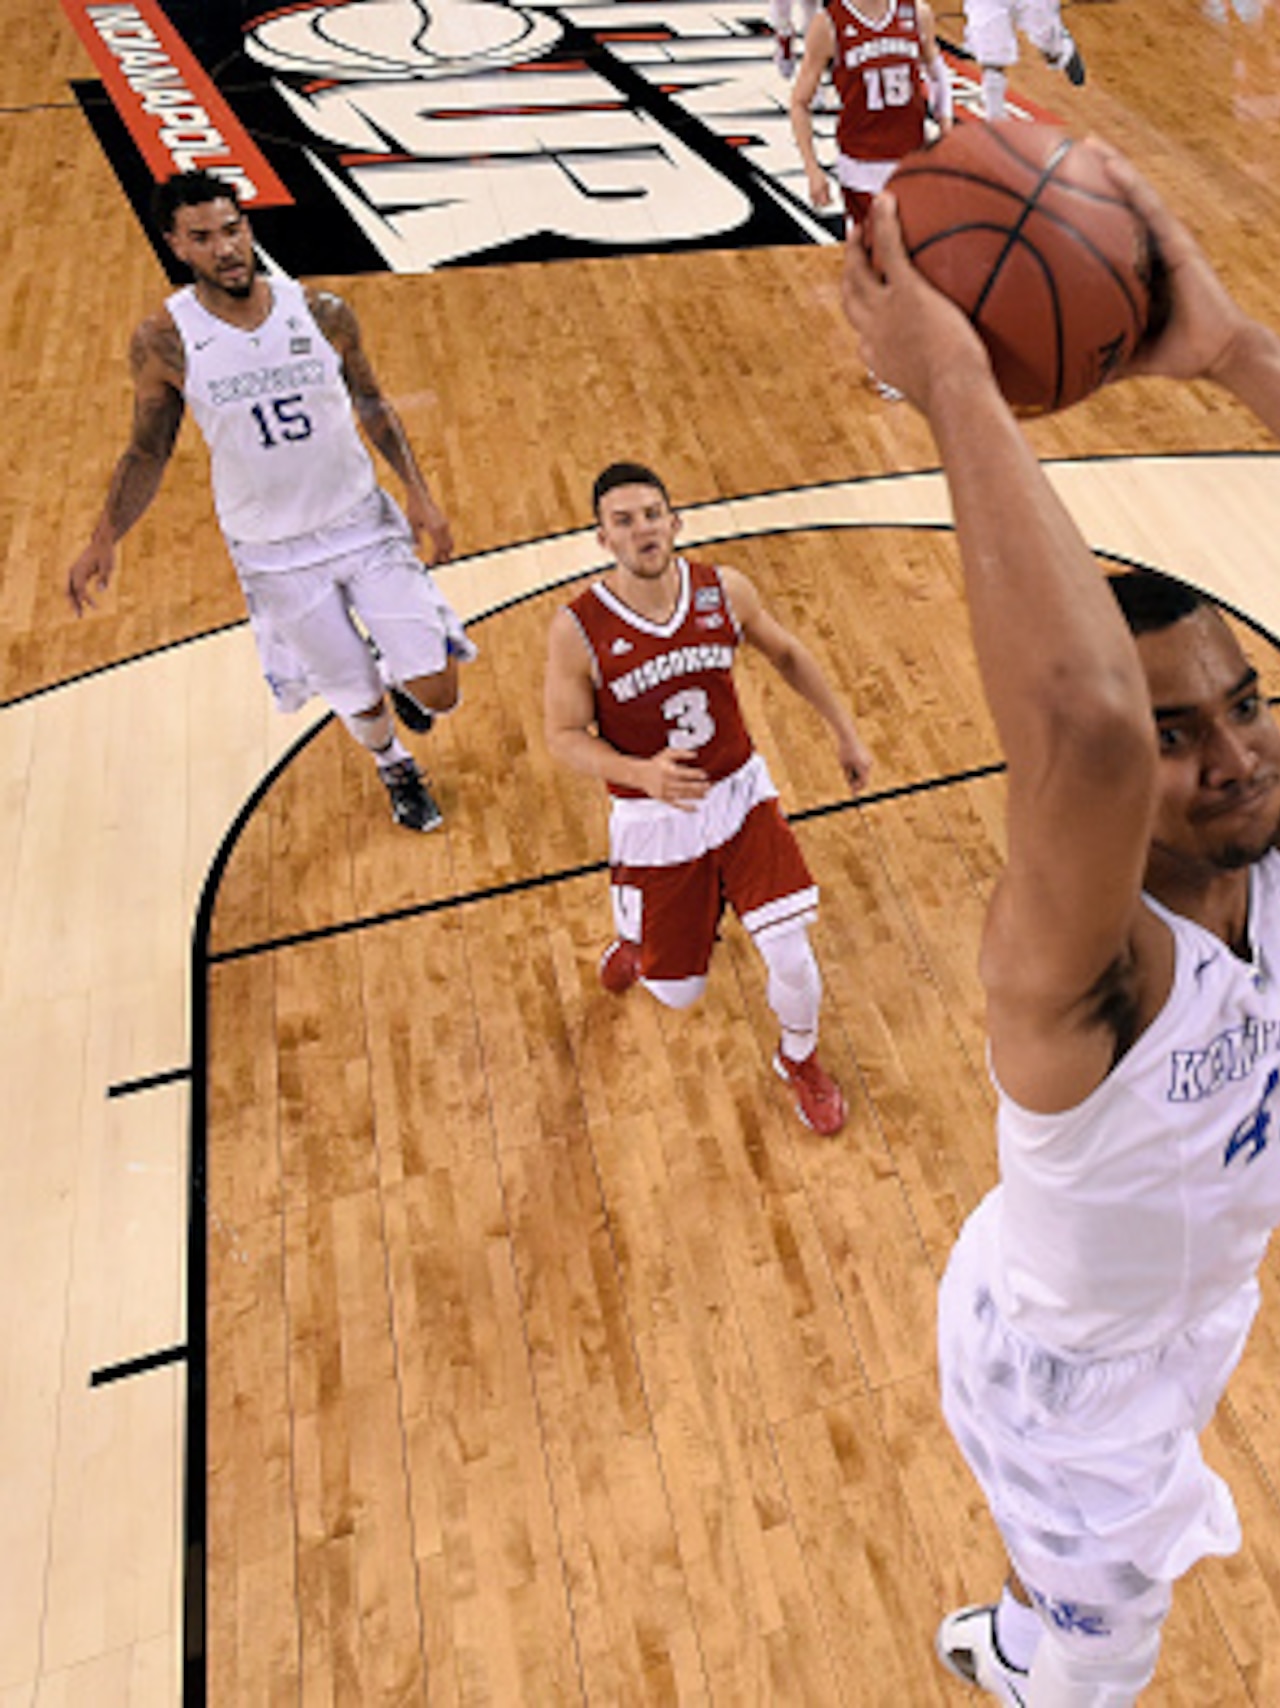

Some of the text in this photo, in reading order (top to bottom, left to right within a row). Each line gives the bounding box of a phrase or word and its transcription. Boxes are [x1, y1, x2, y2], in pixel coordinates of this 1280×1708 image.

[863, 63, 911, 110] 15
[252, 393, 312, 448] 15
[609, 643, 733, 703] WISCONSIN
[660, 687, 716, 751] 3
